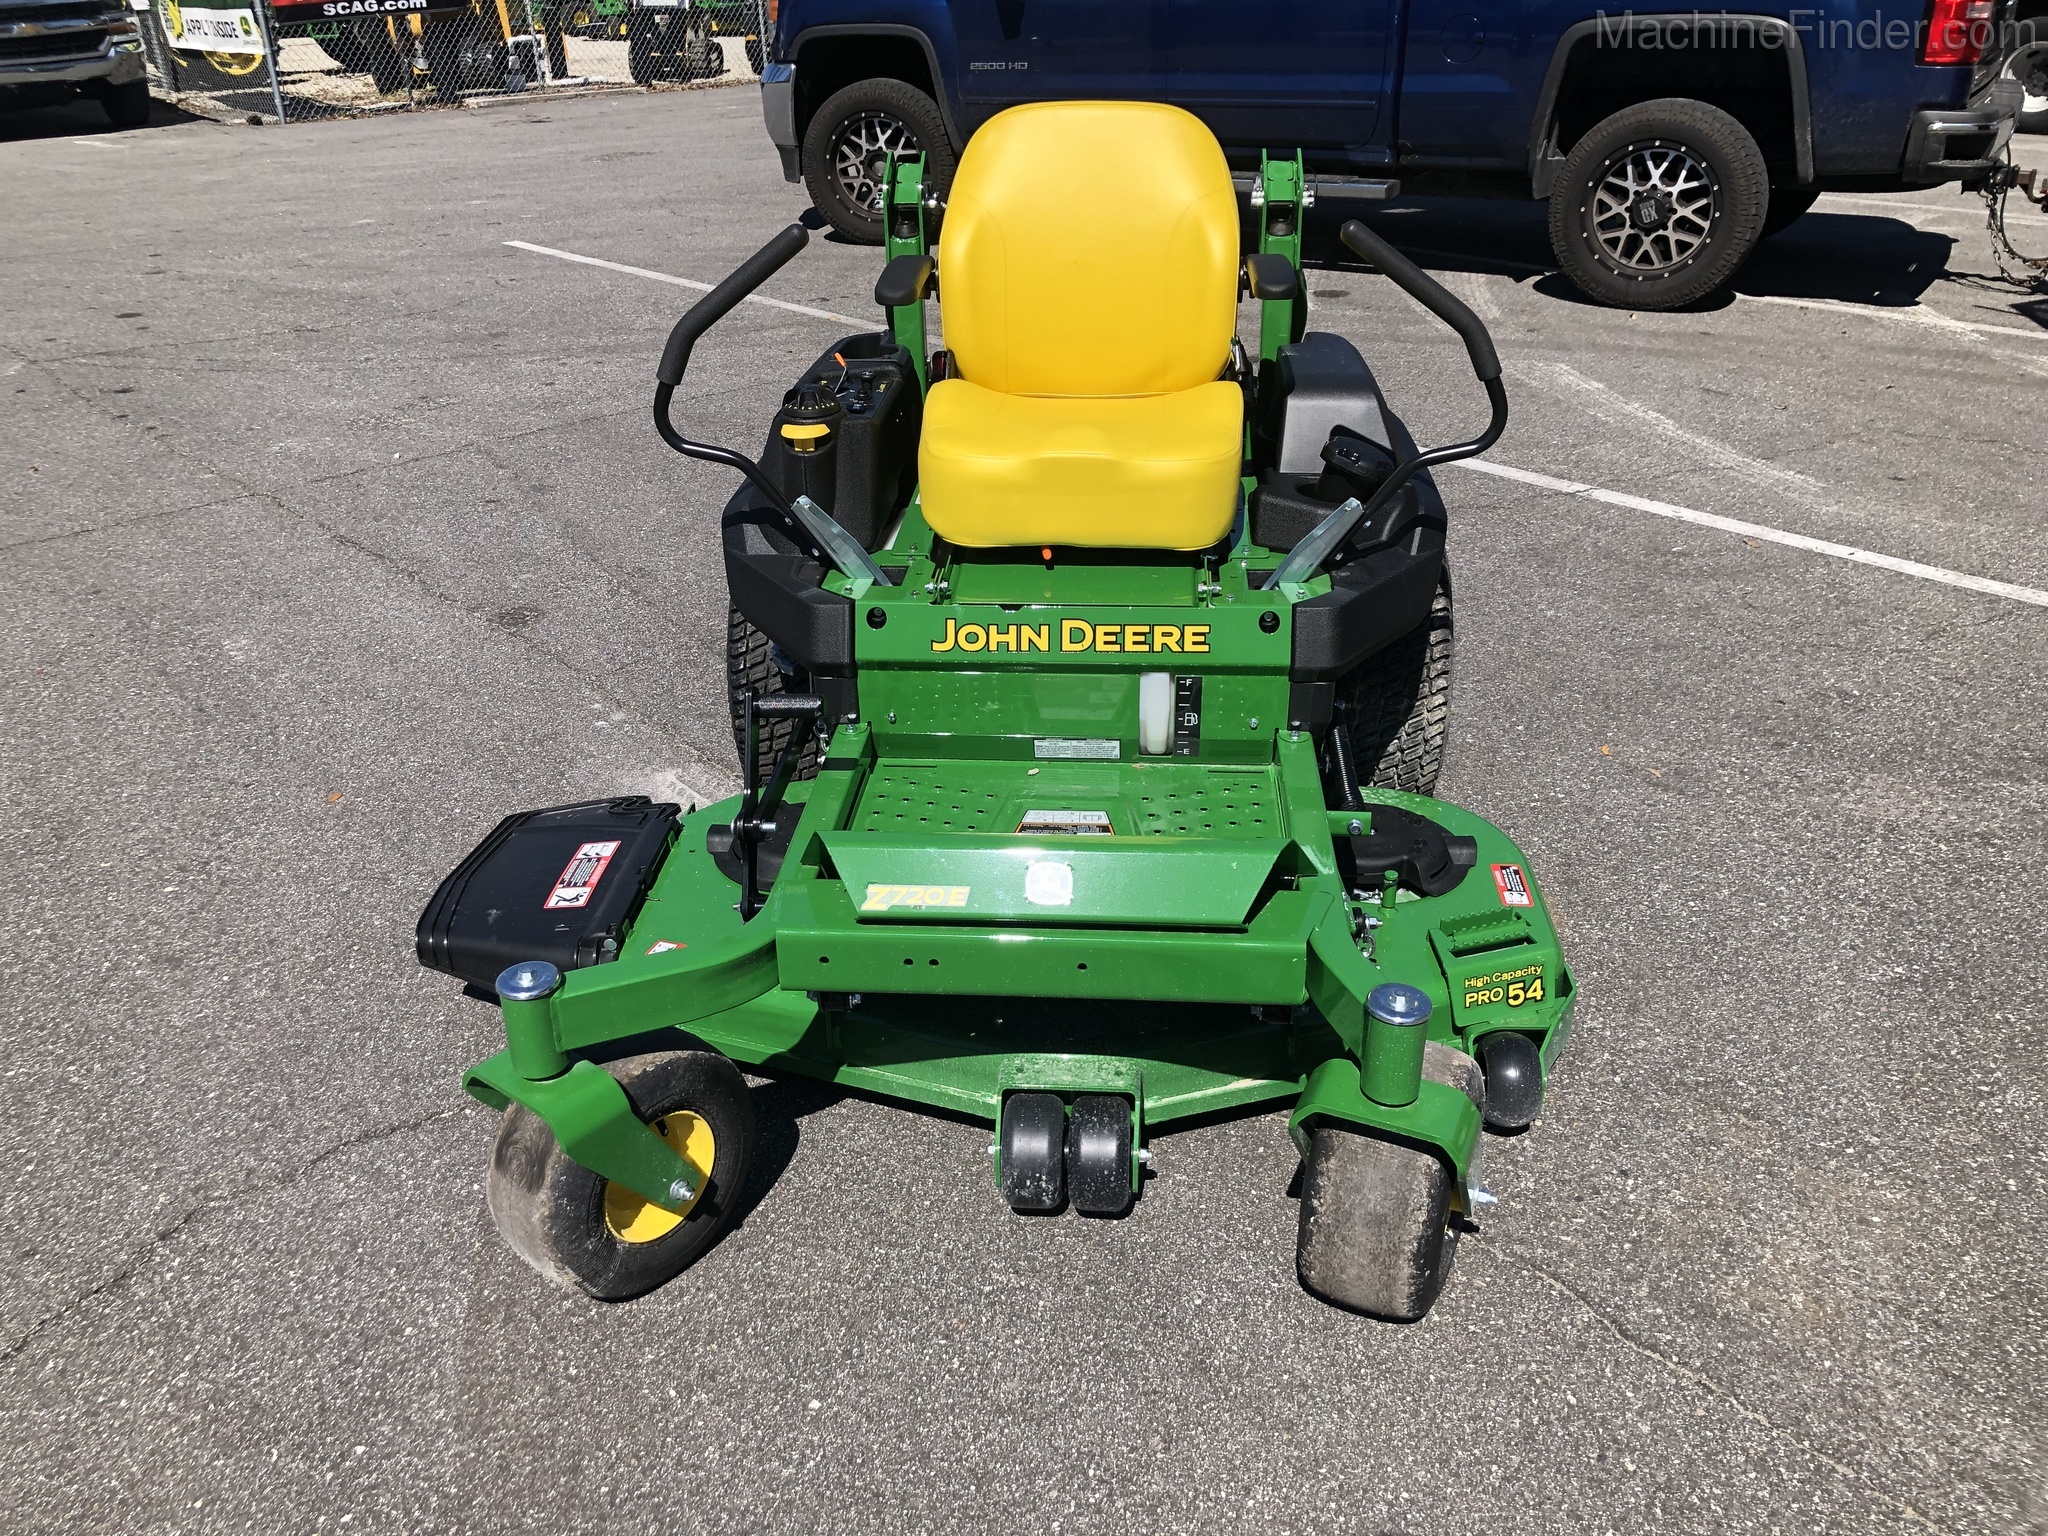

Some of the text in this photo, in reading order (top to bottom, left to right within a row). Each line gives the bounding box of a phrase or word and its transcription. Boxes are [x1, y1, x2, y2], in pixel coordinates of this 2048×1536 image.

[322, 0, 428, 16] SCAG.com
[970, 62, 1028, 70] 2500 HD
[931, 618, 1211, 654] JOHN DEERE
[1186, 678, 1193, 687] F
[1464, 964, 1544, 989] High Capacity
[1464, 976, 1546, 1010] PRO 54
